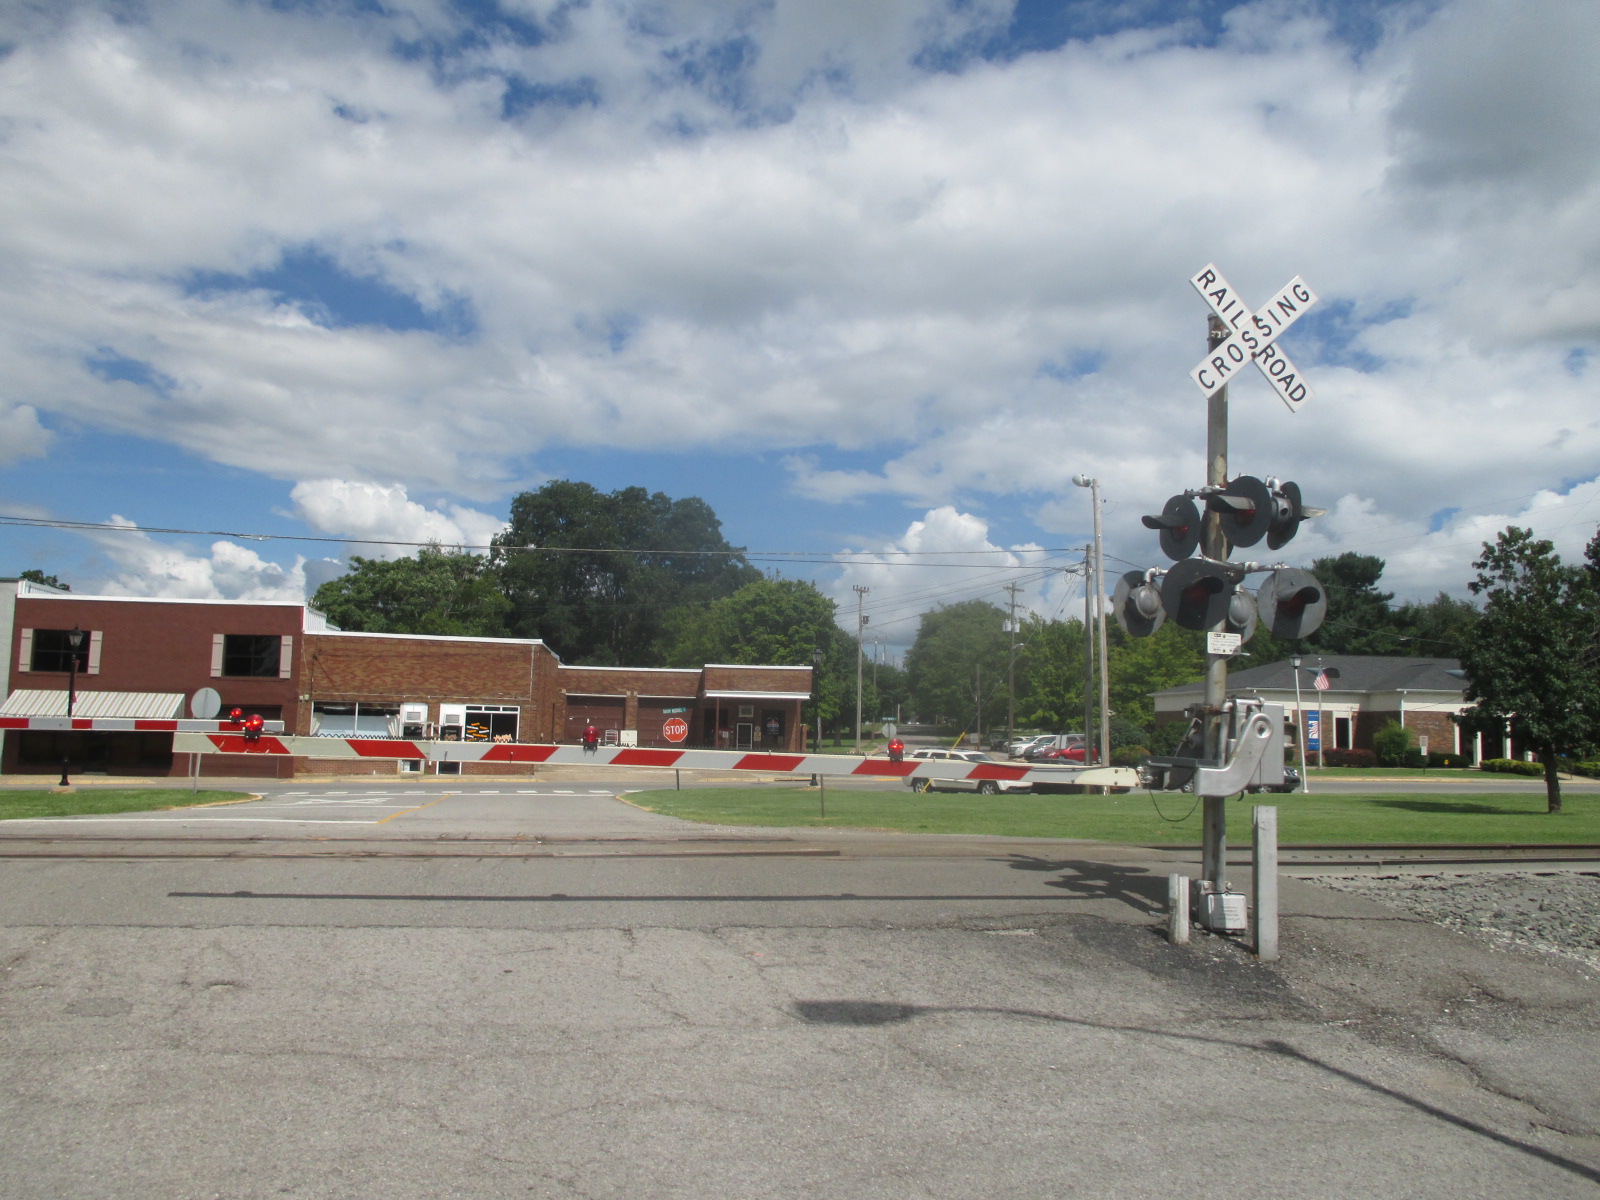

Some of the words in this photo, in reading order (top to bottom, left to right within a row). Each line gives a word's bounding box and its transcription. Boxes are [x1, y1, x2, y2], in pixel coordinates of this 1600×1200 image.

[1197, 268, 1245, 330] RAIL
[1257, 344, 1307, 402] ROAD
[1198, 284, 1310, 390] CROSSING
[665, 725, 686, 735] STOP
